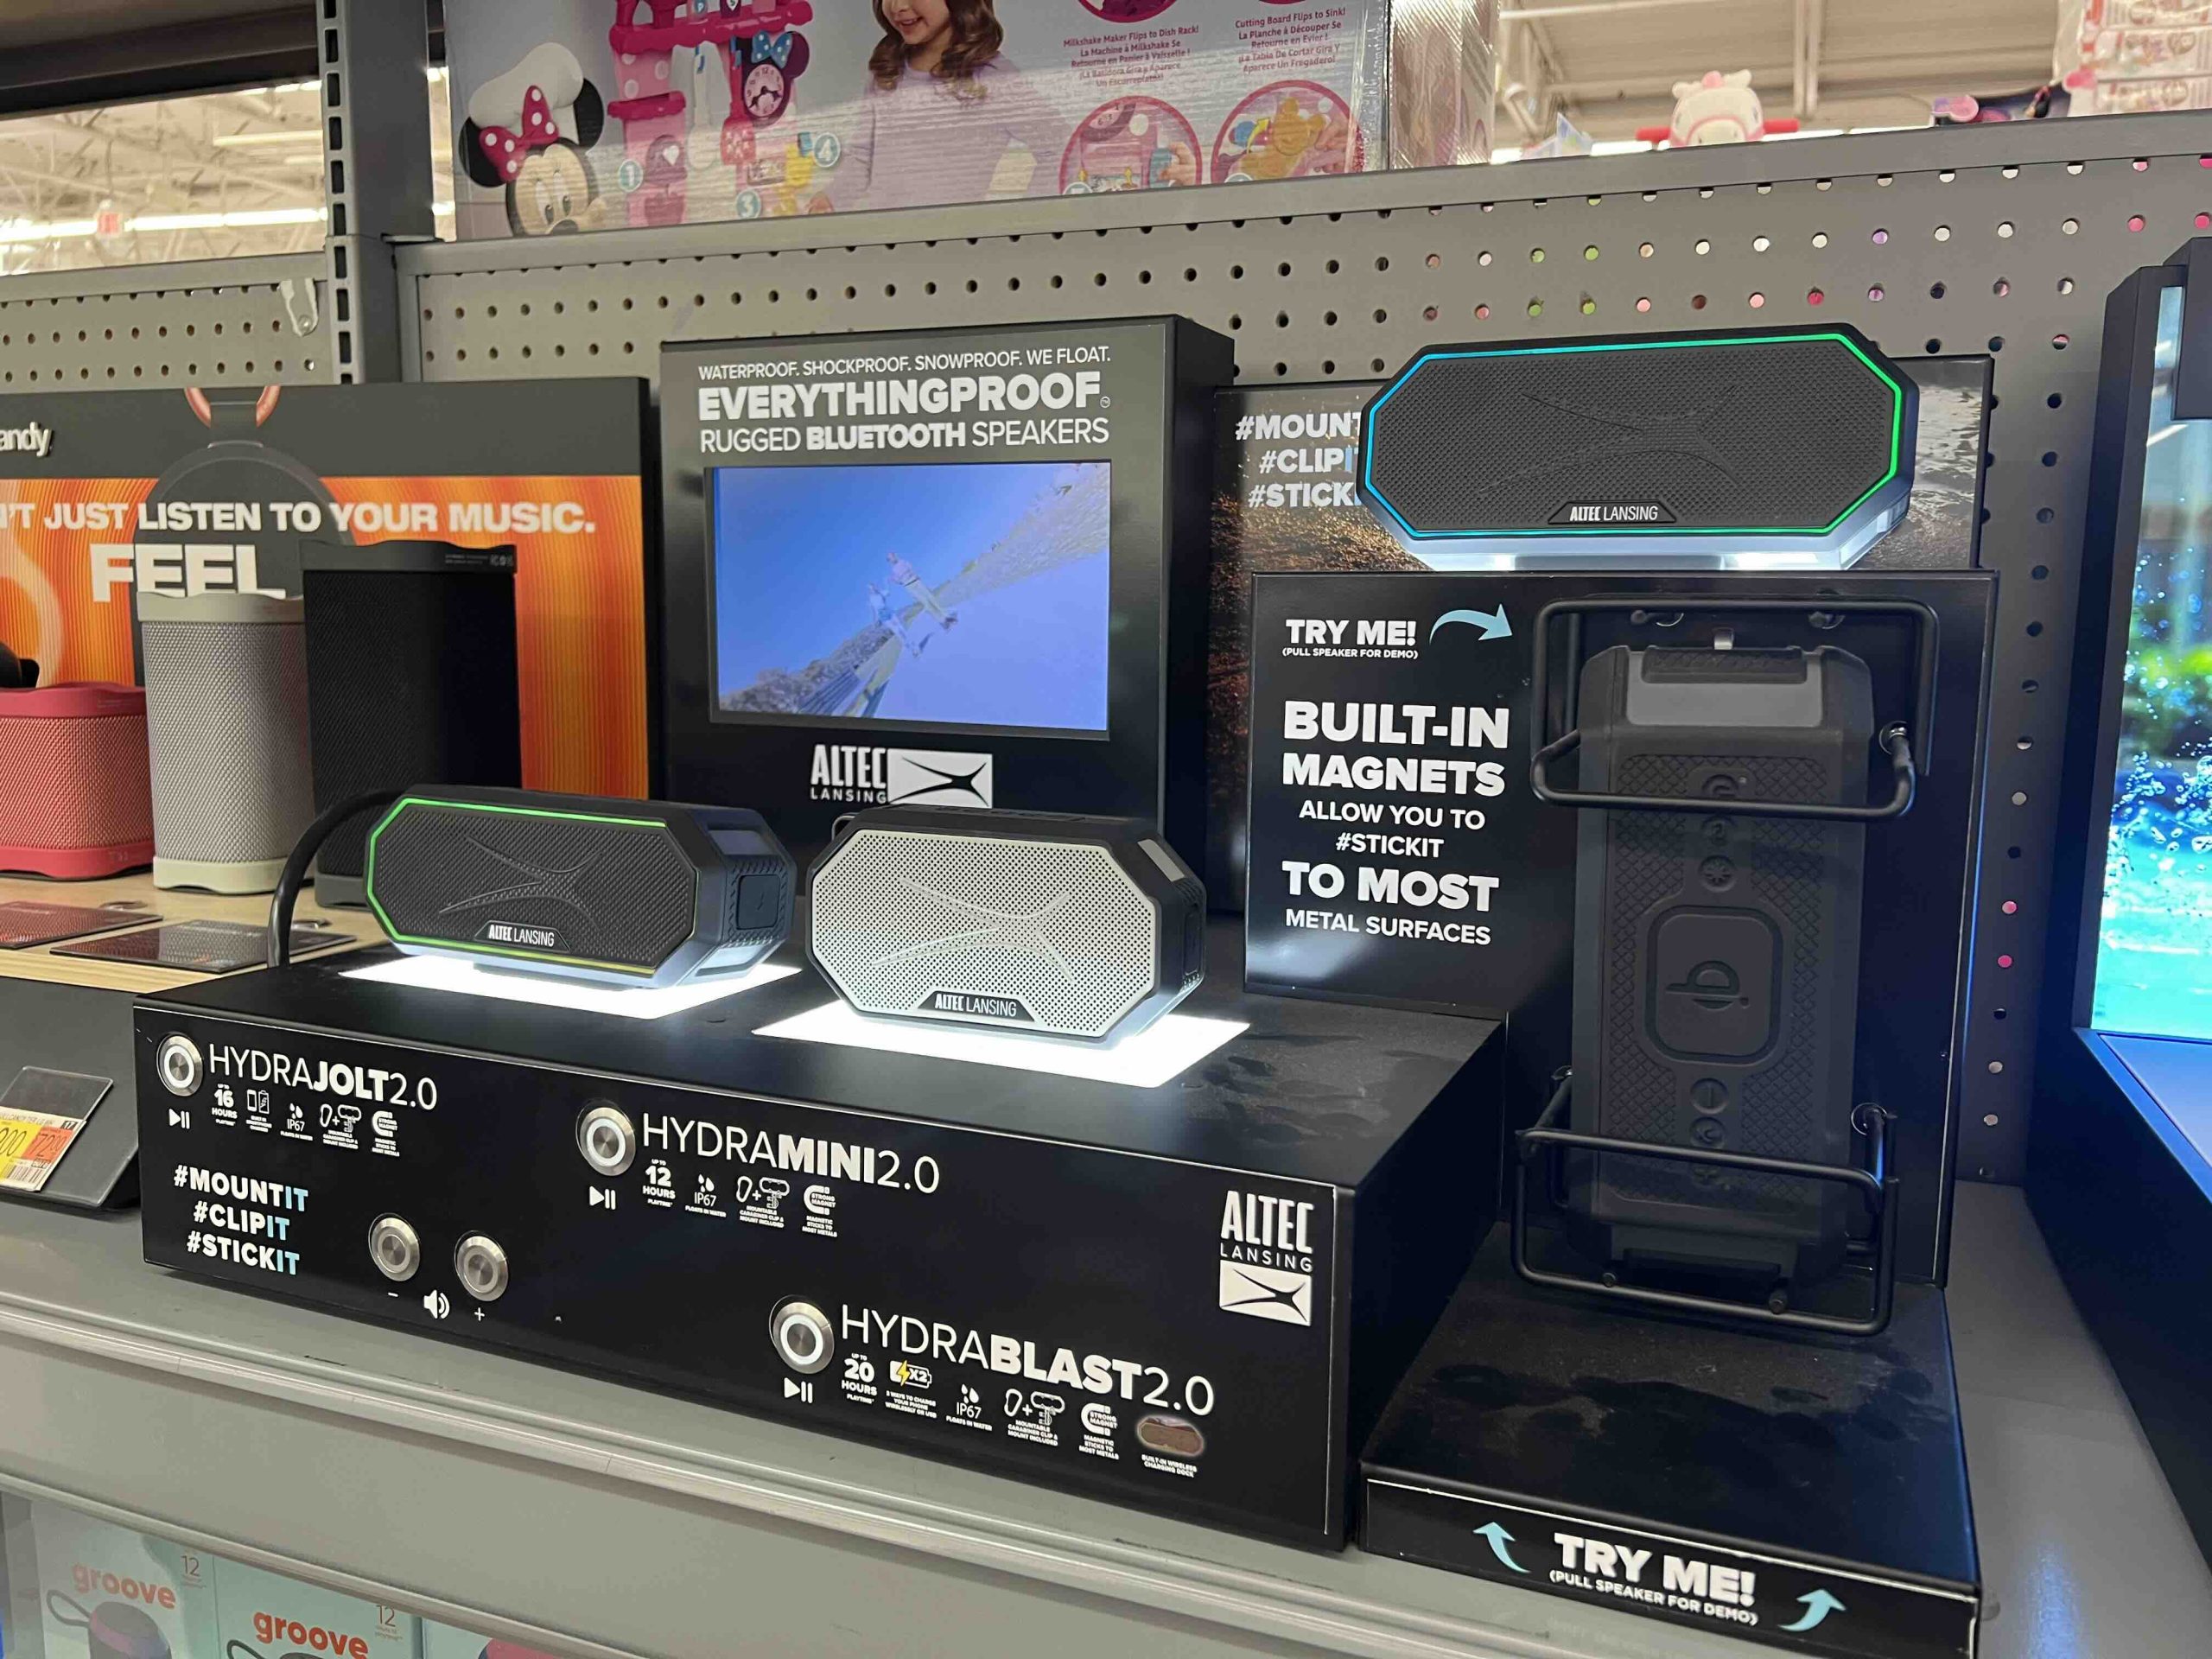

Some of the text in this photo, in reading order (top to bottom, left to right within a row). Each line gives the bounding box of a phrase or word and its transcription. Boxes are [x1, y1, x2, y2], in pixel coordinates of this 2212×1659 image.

[1235, 19, 1265, 29] Cutting
[1267, 15, 1291, 24] Board
[1294, 13, 1313, 23] Flips
[1325, 7, 1346, 17] Sink!
[1064, 37, 1102, 48] Milkshake
[1103, 34, 1127, 42] Maker
[1129, 32, 1147, 41] Flips
[1159, 29, 1176, 37] Dish
[1178, 25, 1199, 35] Rack!
[1249, 29, 1281, 39] Planche
[1290, 22, 1330, 34] Découper
[1091, 46, 1122, 55] Machine
[1131, 41, 1170, 52] Milkshake
[1251, 39, 1288, 48] Retourne
[698, 346, 1111, 380] WATERPROOF. SHOCKPROOF. SNOWPROOF. WE FLOAT.
[697, 371, 1101, 422] EVERYTHINGPROOF
[700, 416, 1109, 453] RUGGED BLUETOOTH SPEAKERS
[44, 502, 129, 530] JUST
[137, 502, 262, 531] LISTEN
[269, 502, 321, 531] TO
[329, 501, 438, 532] YOUR
[448, 501, 596, 533] MUSIC.
[1569, 505, 1658, 522] ALTEC LANSING
[89, 543, 286, 602] FEEL
[1286, 619, 1417, 646] TRY ME!
[1282, 647, 1419, 660] (PULL SPEAKER FOR DEMO)
[1284, 700, 1510, 749] BUILT-IN
[810, 744, 887, 789] ALTEC
[1282, 753, 1505, 797] MAGNETS
[810, 786, 887, 804] LANSING
[1299, 799, 1485, 830] ALLOW YOU TO
[1336, 832, 1444, 858] #STICKIT
[1281, 860, 1500, 912] TO MOST
[488, 925, 555, 947] ALTEC LANSING
[1286, 909, 1491, 945] METAL SURFACES
[934, 993, 1017, 1017] ALTEC LANSING
[209, 1043, 437, 1110] HYDRAJOLT2.0
[213, 1089, 234, 1108] 16
[211, 1107, 238, 1119] HOURS
[287, 1118, 305, 1132] IP67
[644, 1113, 939, 1194] HYDRAMINI2.0
[645, 1165, 671, 1187] 12
[174, 1164, 308, 1212] #MOUNTIT
[642, 1185, 676, 1199] HOURS
[694, 1192, 717, 1207] IP67
[194, 1200, 290, 1241] #CLIPIT
[1221, 1190, 1314, 1254] ALTEC
[187, 1230, 300, 1275] #STICKIT
[1220, 1242, 1313, 1273] LANSING
[842, 1304, 1214, 1415] HYDRABLAST2.0
[844, 1357, 875, 1382] 20
[909, 1368, 928, 1382] X2
[841, 1380, 878, 1396] HOURS
[891, 1391, 906, 1400] WAYS
[914, 1396, 936, 1407] CHARGE
[909, 1402, 928, 1410] PHONE
[956, 1402, 982, 1419] IP67
[1090, 1411, 1116, 1422] STRONG
[946, 1415, 966, 1426] FLOATS
[973, 1421, 992, 1431] WATER
[1015, 1420, 1051, 1433] MOUNTABLE
[1090, 1417, 1117, 1429] MAGNET
[1007, 1430, 1058, 1446] MOUNT INCLUDED
[1084, 1434, 1114, 1446] MAGNETIC
[1084, 1440, 1104, 1451] STICKS
[1079, 1445, 1119, 1460] MOST METALS
[1144, 1461, 1194, 1478] CHARGING DOCK
[1167, 1459, 1198, 1472] WIRELESS
[181, 1555, 200, 1577] 12
[1554, 1532, 1756, 1607] TRY ME!
[72, 1562, 176, 1610] groove
[1549, 1569, 1758, 1627] (PULL SPEAKER FOR DEMO)
[376, 1604, 396, 1627] 12
[253, 1611, 369, 1659] groove
